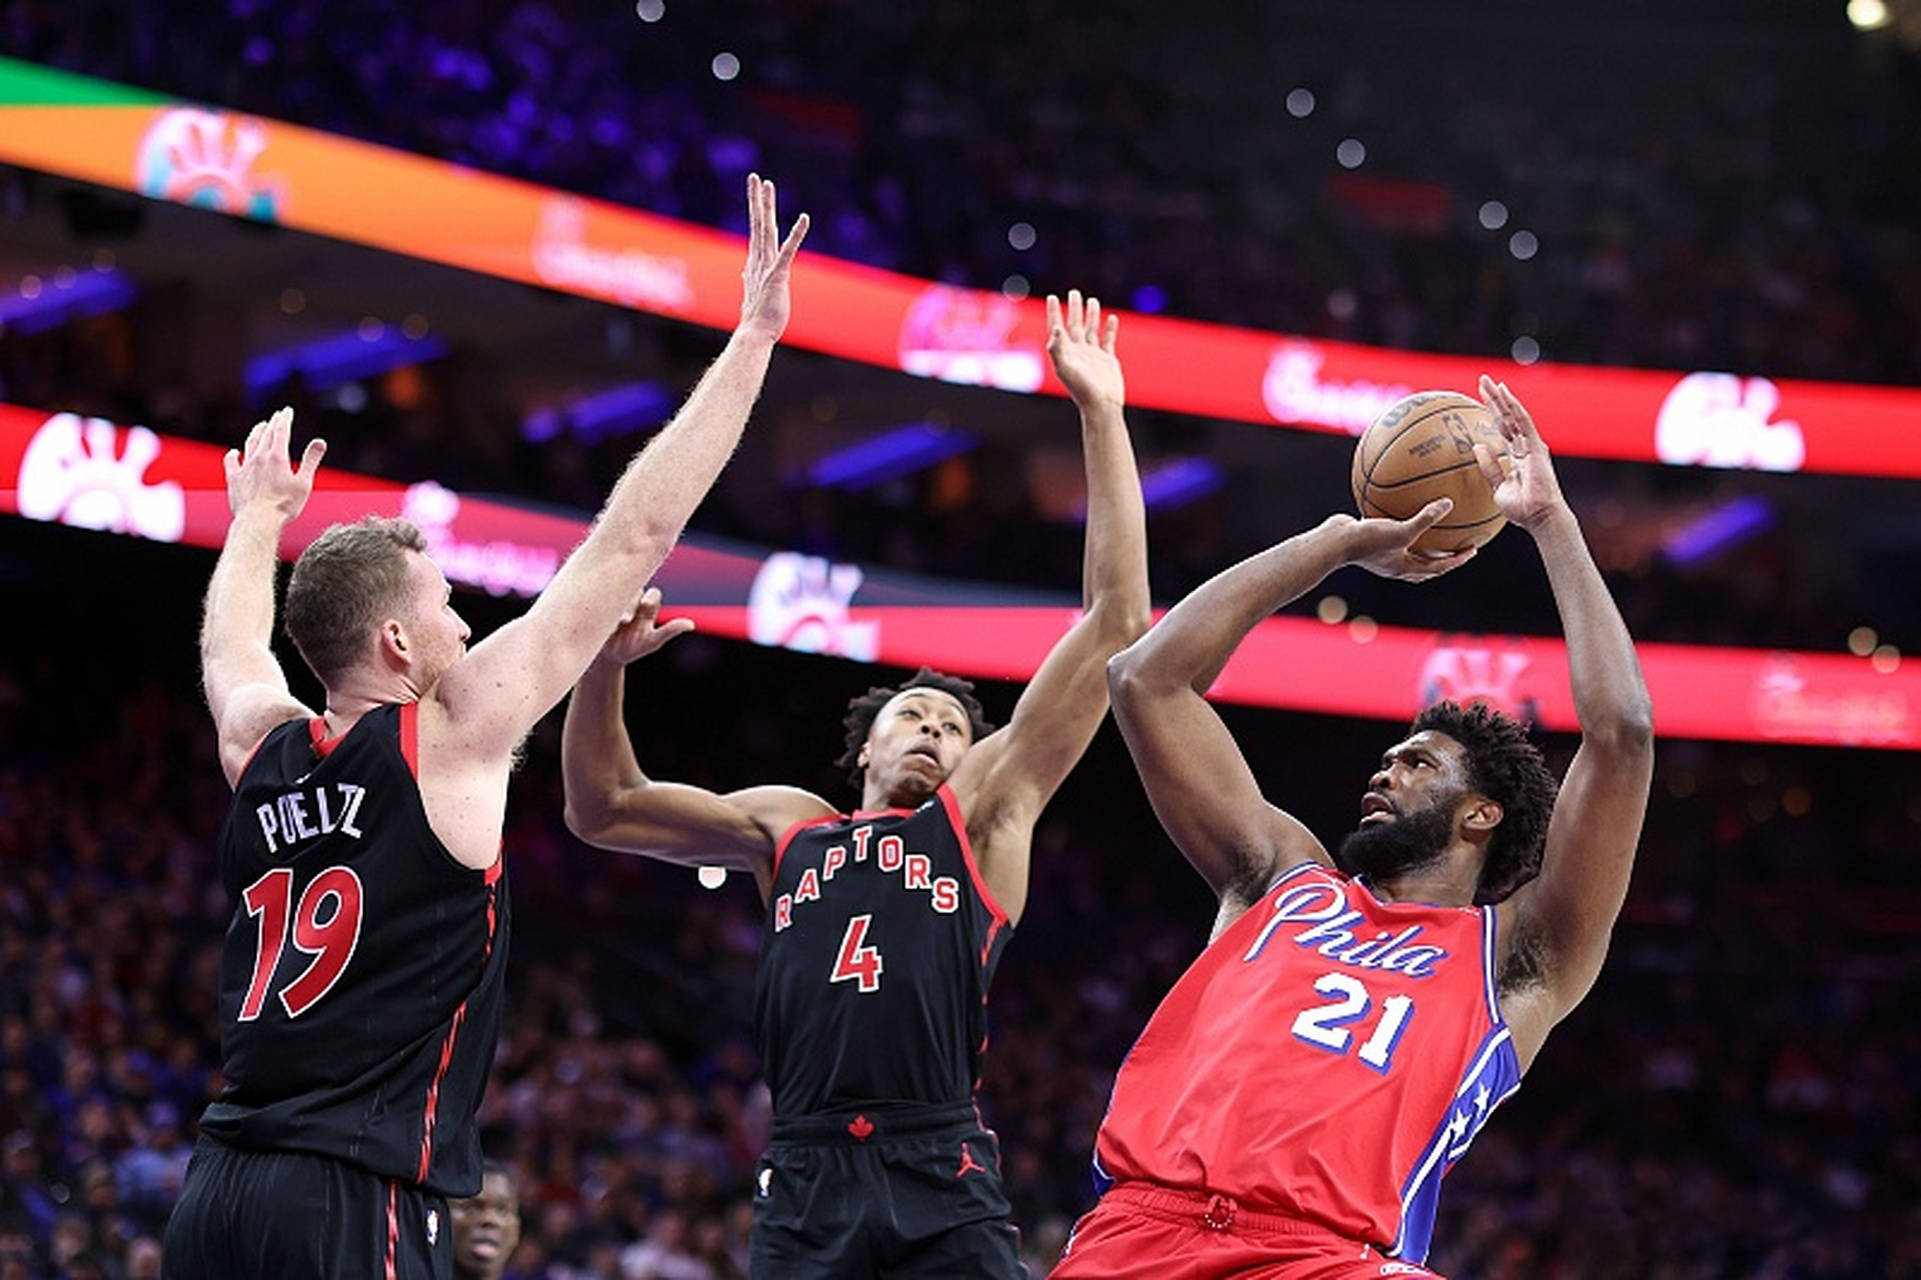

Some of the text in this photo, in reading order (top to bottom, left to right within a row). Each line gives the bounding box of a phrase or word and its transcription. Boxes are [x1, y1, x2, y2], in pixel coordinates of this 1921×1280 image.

[775, 826, 959, 932] RAPTORS
[1243, 882, 1448, 979] Phila
[237, 866, 364, 1023] 19
[830, 914, 883, 993] 4
[1291, 972, 1415, 1077] 21
